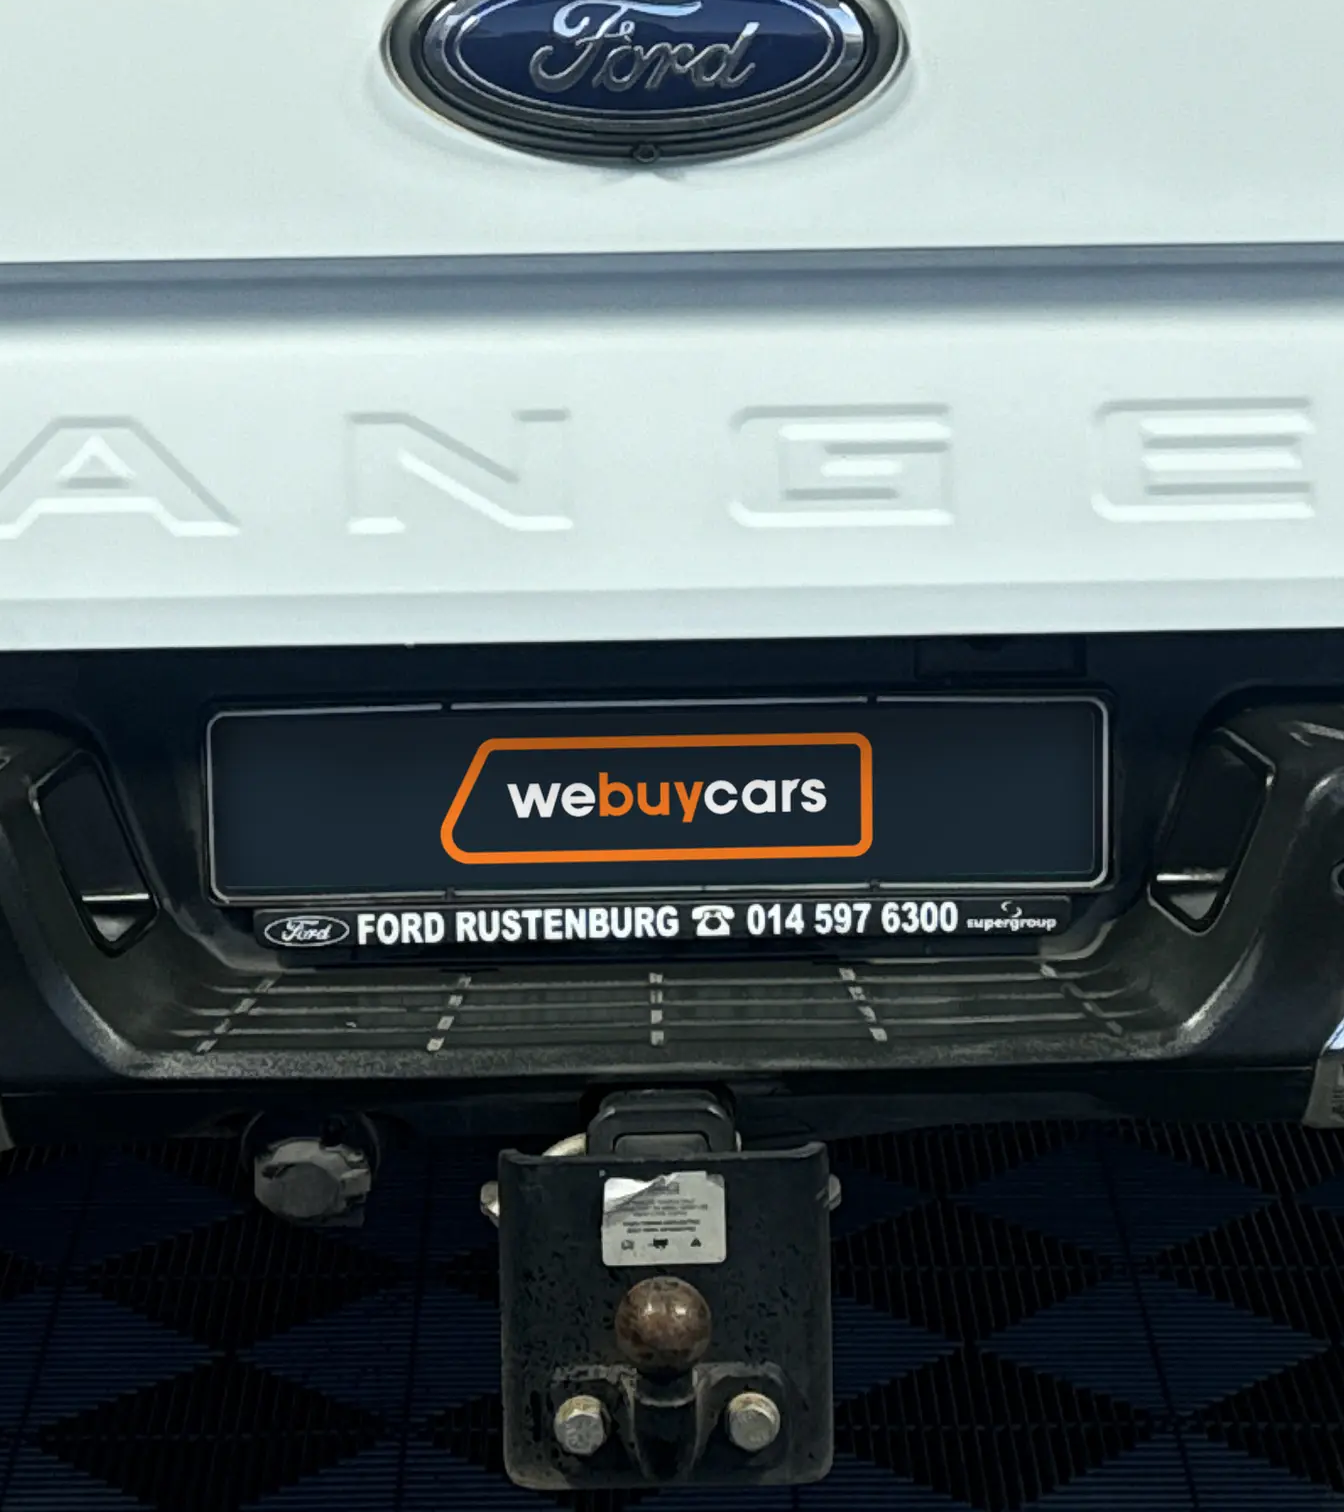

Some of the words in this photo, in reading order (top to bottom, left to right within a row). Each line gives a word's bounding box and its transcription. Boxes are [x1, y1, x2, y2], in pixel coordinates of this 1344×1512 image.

[506, 772, 828, 823] webuycars
[281, 920, 332, 942] Ford
[357, 912, 445, 945] FORD
[456, 906, 680, 942] RUSTENBURG
[746, 903, 805, 935] 014
[814, 902, 872, 934] 597
[881, 901, 958, 934] 6300
[966, 917, 1057, 931] supergroup
